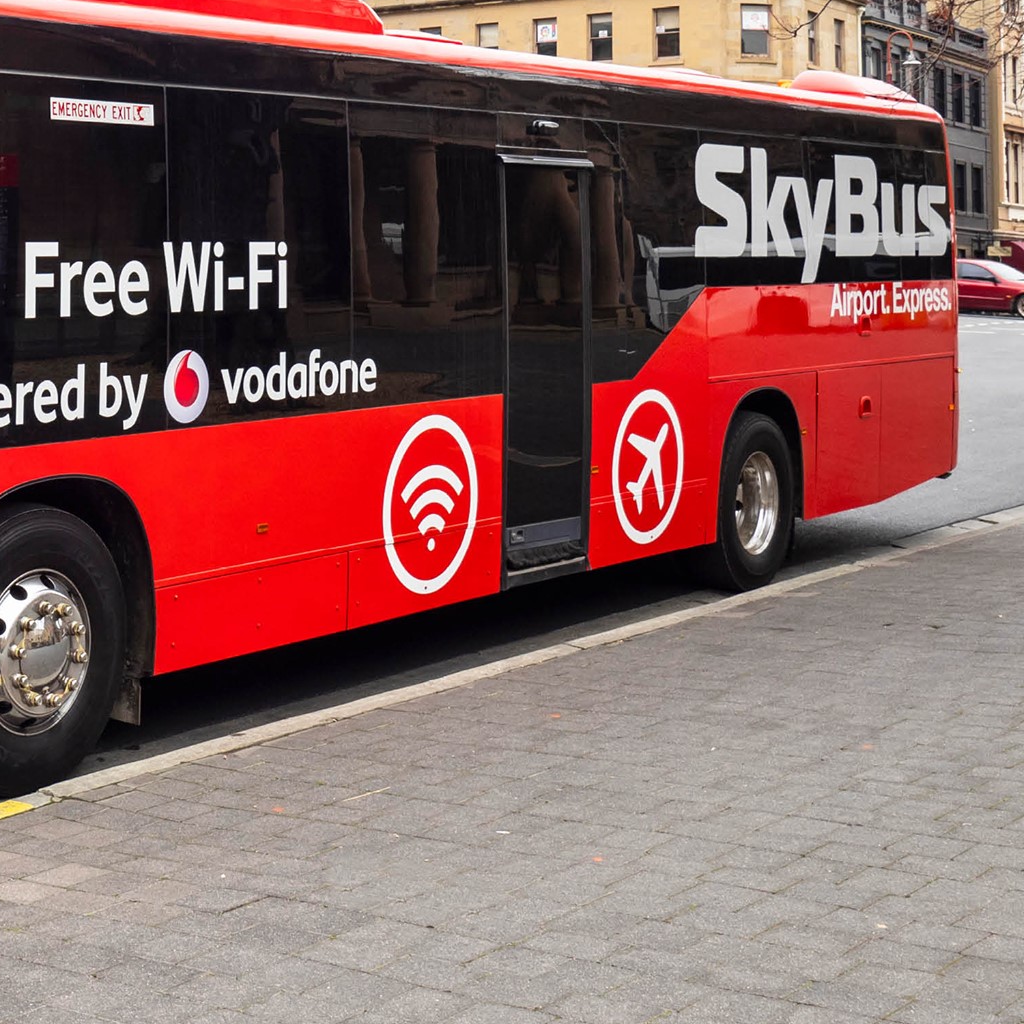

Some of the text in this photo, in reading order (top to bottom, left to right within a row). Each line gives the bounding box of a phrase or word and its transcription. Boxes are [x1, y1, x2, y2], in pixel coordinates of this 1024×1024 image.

[52, 101, 131, 120] EMERGENCY EXIT
[694, 143, 948, 284] SkyBus
[24, 241, 288, 319] Free Wi-Fi
[98, 362, 149, 430] by
[220, 348, 377, 404] vodafone
